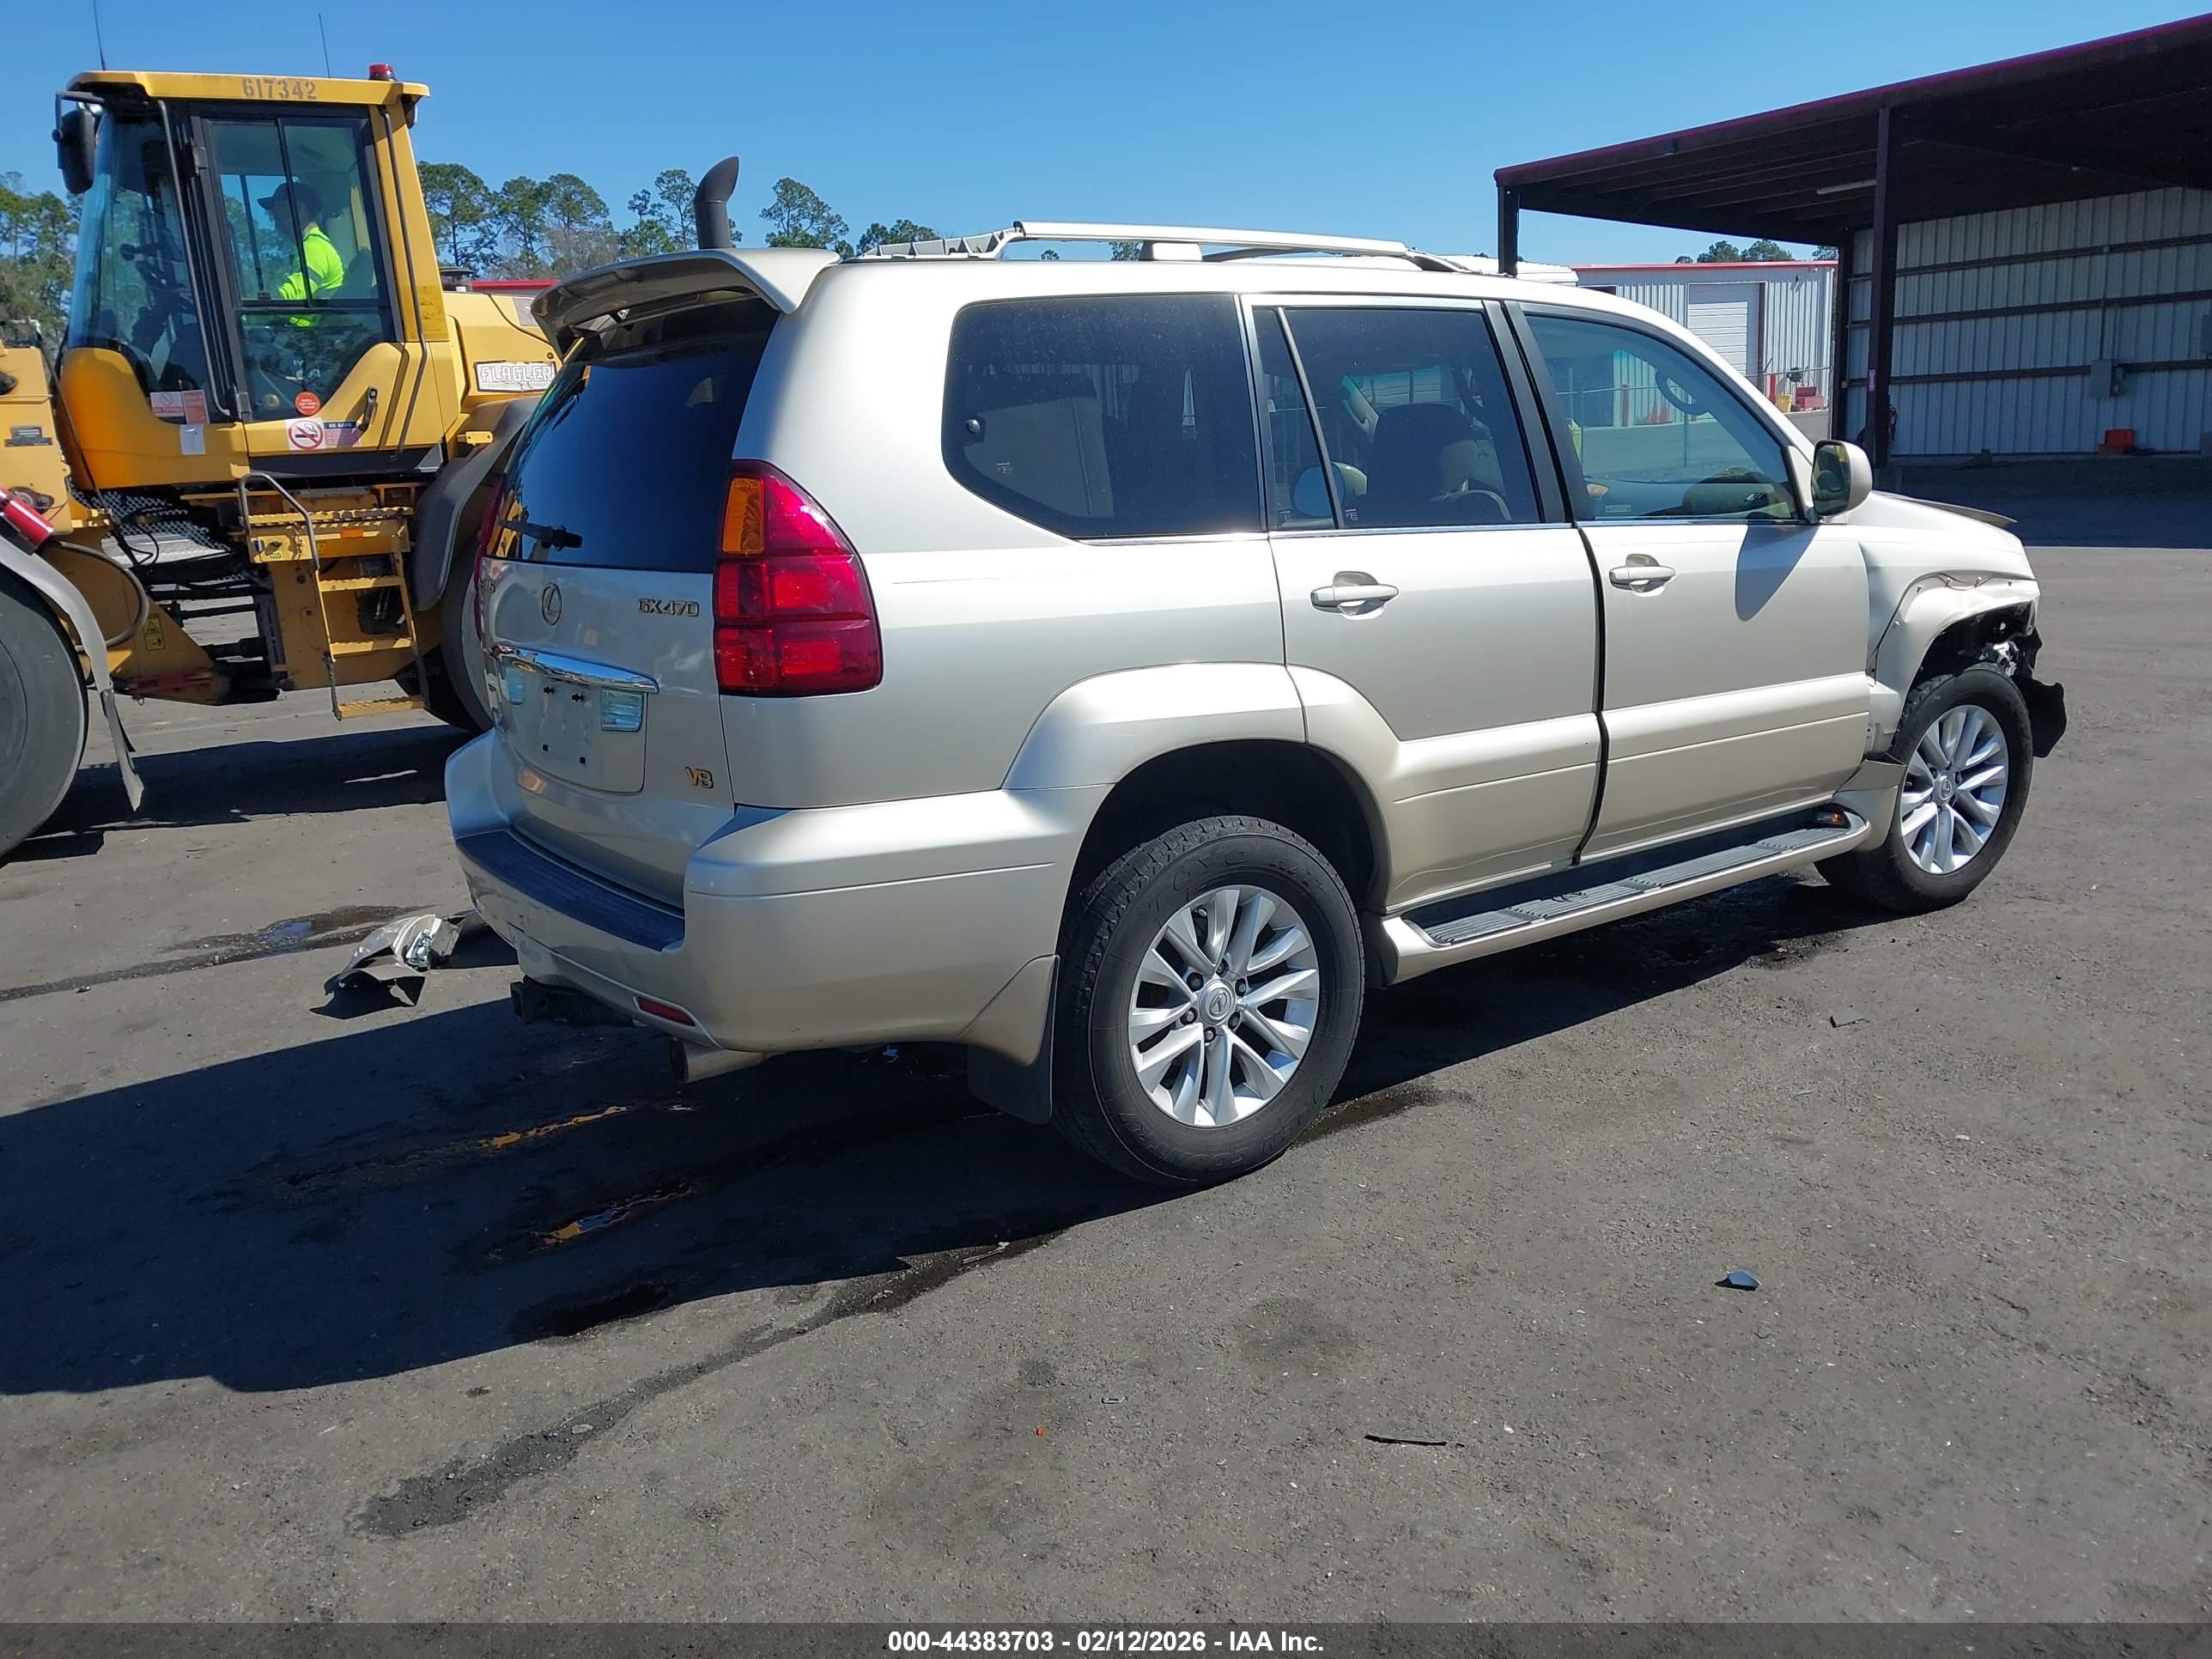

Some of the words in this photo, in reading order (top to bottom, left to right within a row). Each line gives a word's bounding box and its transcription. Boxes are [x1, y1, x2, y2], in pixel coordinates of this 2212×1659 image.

[242, 77, 318, 100] 617342
[481, 365, 553, 383] FLAGLER
[639, 599, 700, 617] GX470
[684, 766, 714, 789] V8
